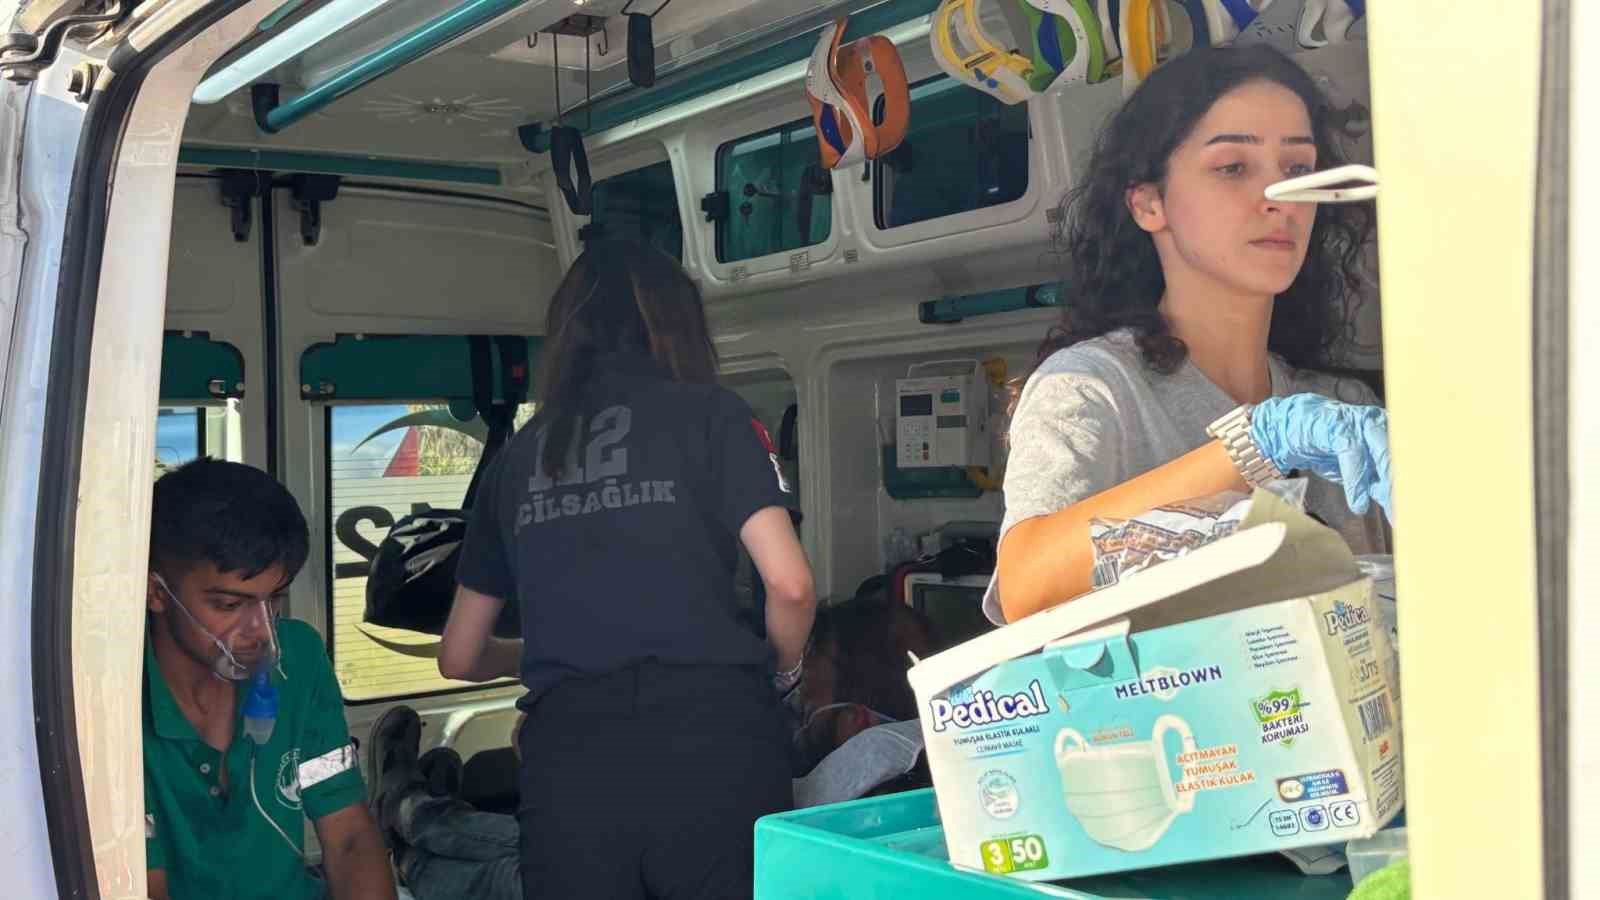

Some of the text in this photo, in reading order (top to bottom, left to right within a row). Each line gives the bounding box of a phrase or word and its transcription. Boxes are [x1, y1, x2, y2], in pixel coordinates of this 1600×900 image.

[513, 477, 676, 536] CİLSAĞLIK
[1114, 665, 1222, 699] MELTBLOWN
[929, 678, 1050, 733] Pedical
[1262, 712, 1303, 733] BAKTERİ
[1261, 723, 1310, 744] KORUMASI
[1177, 745, 1237, 764] ACITMAYAN
[1185, 760, 1237, 778] YUMUŞAK
[1333, 804, 1355, 822] CE
[986, 837, 1043, 866] 3 50
